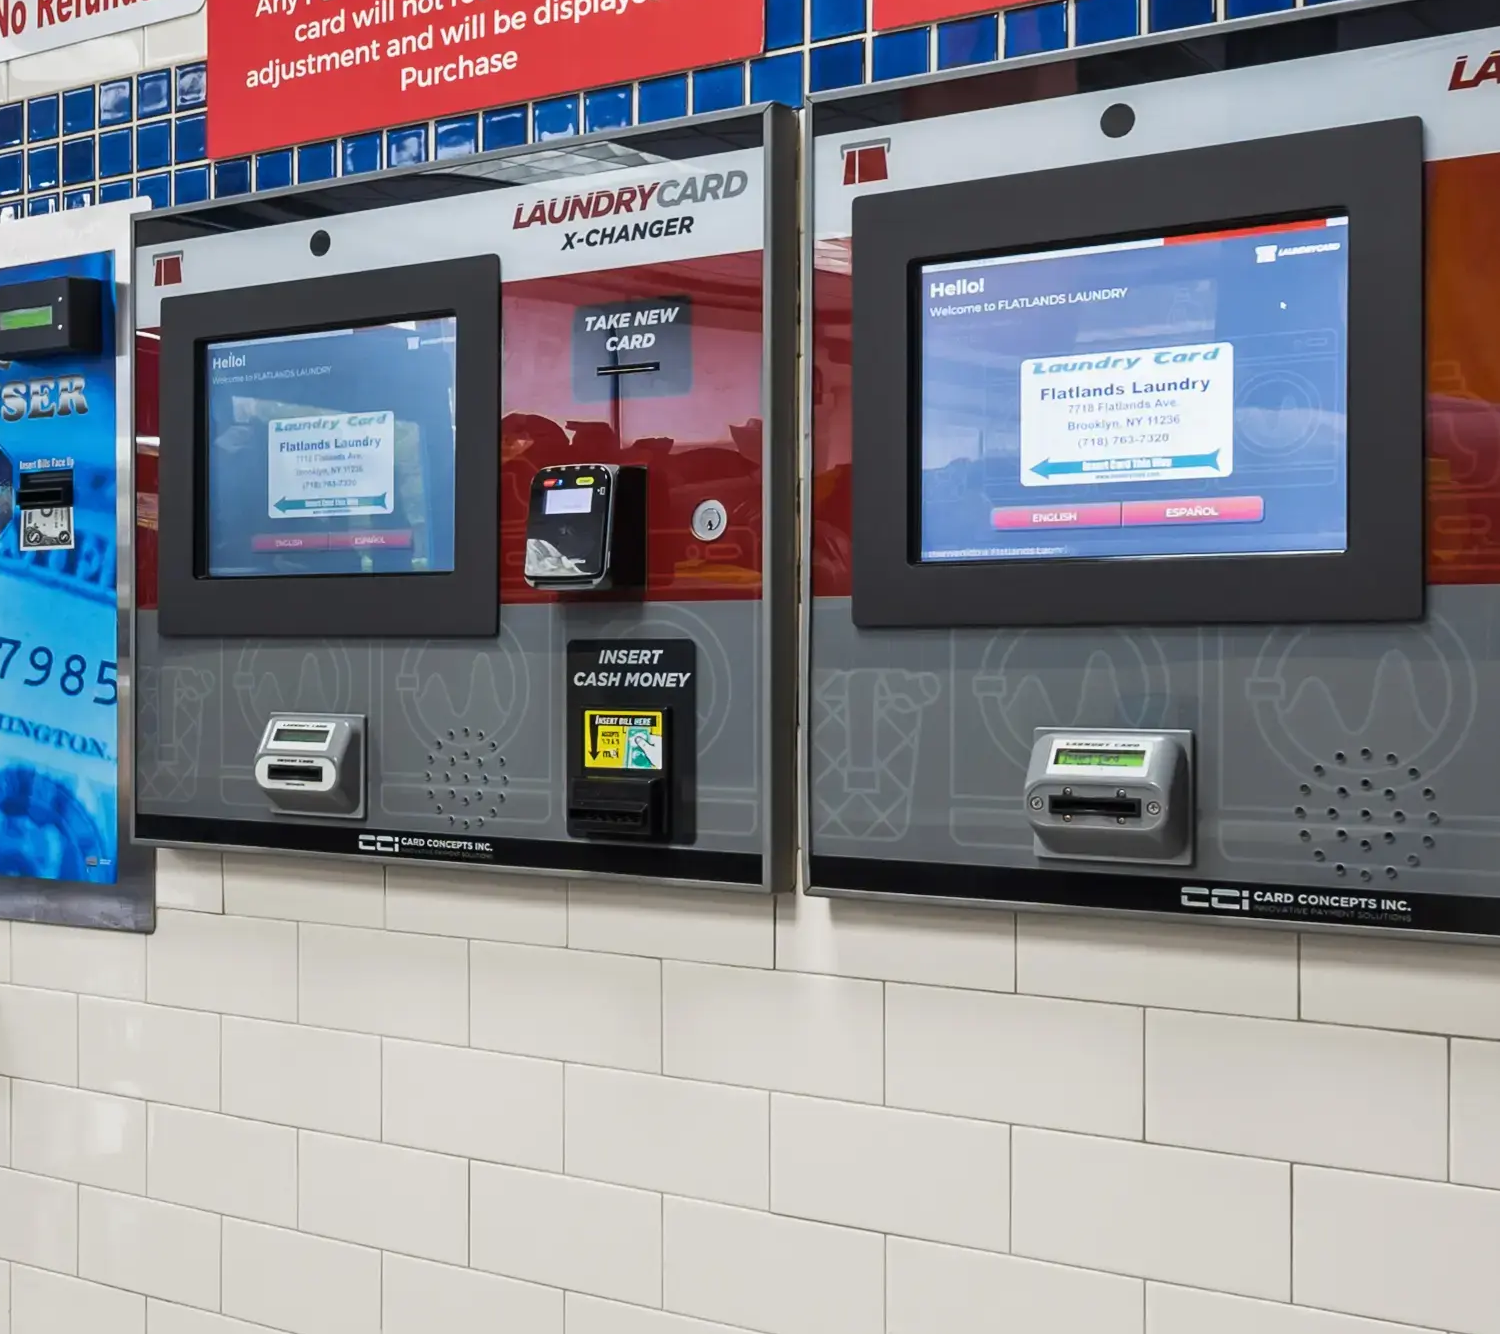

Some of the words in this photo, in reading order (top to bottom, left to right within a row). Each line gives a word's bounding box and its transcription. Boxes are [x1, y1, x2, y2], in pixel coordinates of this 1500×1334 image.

[512, 170, 748, 229] LAUNDRYCARD
[561, 216, 694, 250] X-CHANGER
[930, 278, 984, 298] Hello!
[930, 303, 981, 317] Welcome
[984, 302, 996, 312] to
[998, 294, 1066, 311] FLATLANDS
[1068, 287, 1128, 304] LAUNDRY
[1033, 355, 1141, 375] Laundry
[1153, 347, 1221, 365] Card
[1040, 384, 1125, 401] Flatlands
[1132, 377, 1211, 395] Laundry
[1032, 512, 1077, 523] ENGLISH
[1165, 504, 1219, 518] ESPAÑOL
[1253, 891, 1295, 904] CARD
[1297, 894, 1378, 909] CONCEPTS
[1380, 899, 1412, 912] INC.
